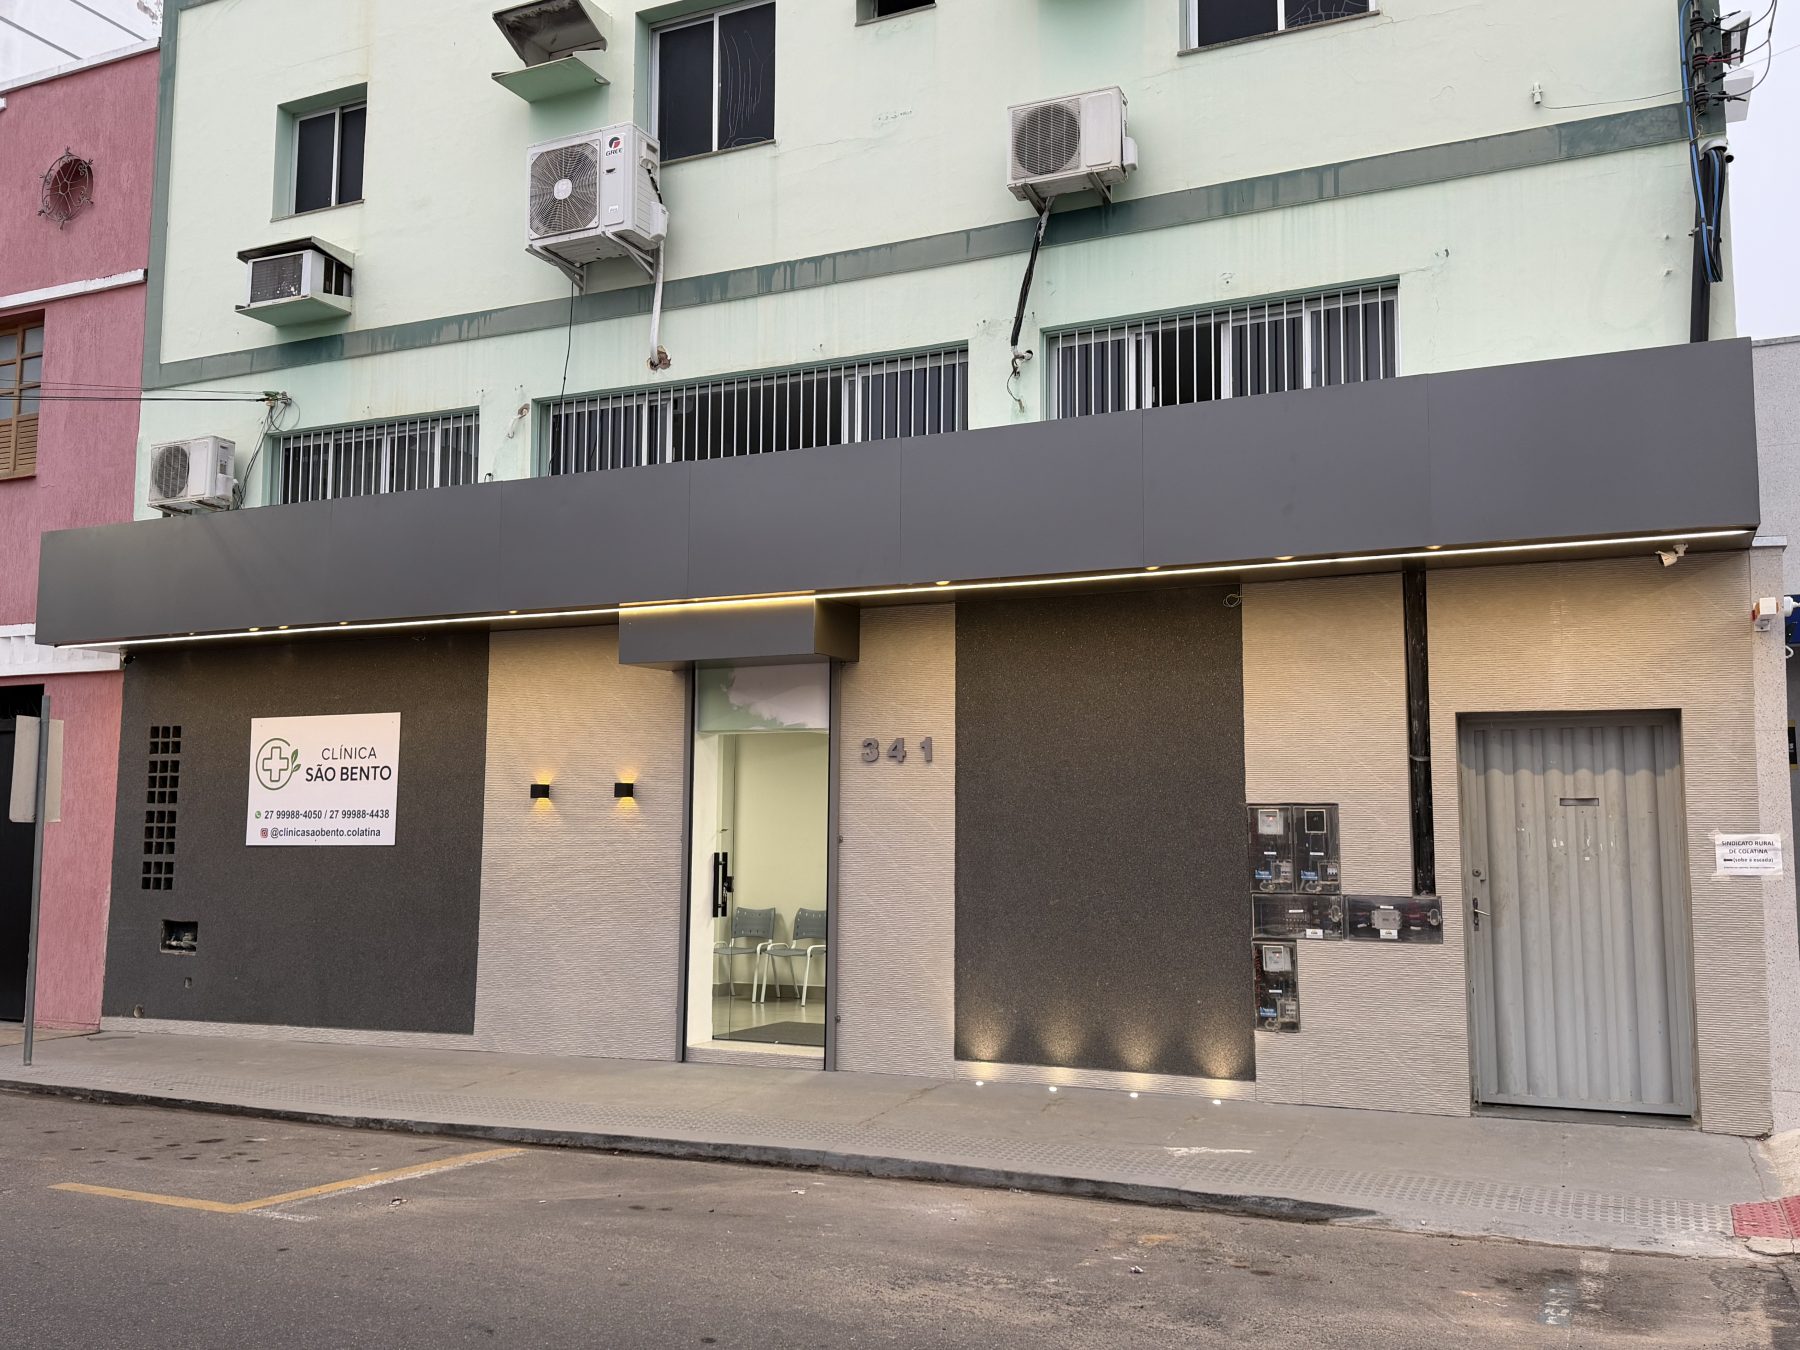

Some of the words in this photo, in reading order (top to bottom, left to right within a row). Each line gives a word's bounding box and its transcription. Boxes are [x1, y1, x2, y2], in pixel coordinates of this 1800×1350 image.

[321, 744, 377, 760] CLÍNICA
[861, 737, 932, 763] 341
[305, 764, 336, 782] SÃO
[340, 766, 392, 781] BENTO
[264, 810, 274, 819] 27
[276, 810, 322, 819] 99988-4050
[324, 810, 328, 819] /
[329, 810, 339, 819] 27
[341, 809, 390, 818] 99988-4438
[270, 827, 380, 838] @clinicasaobento.colatina
